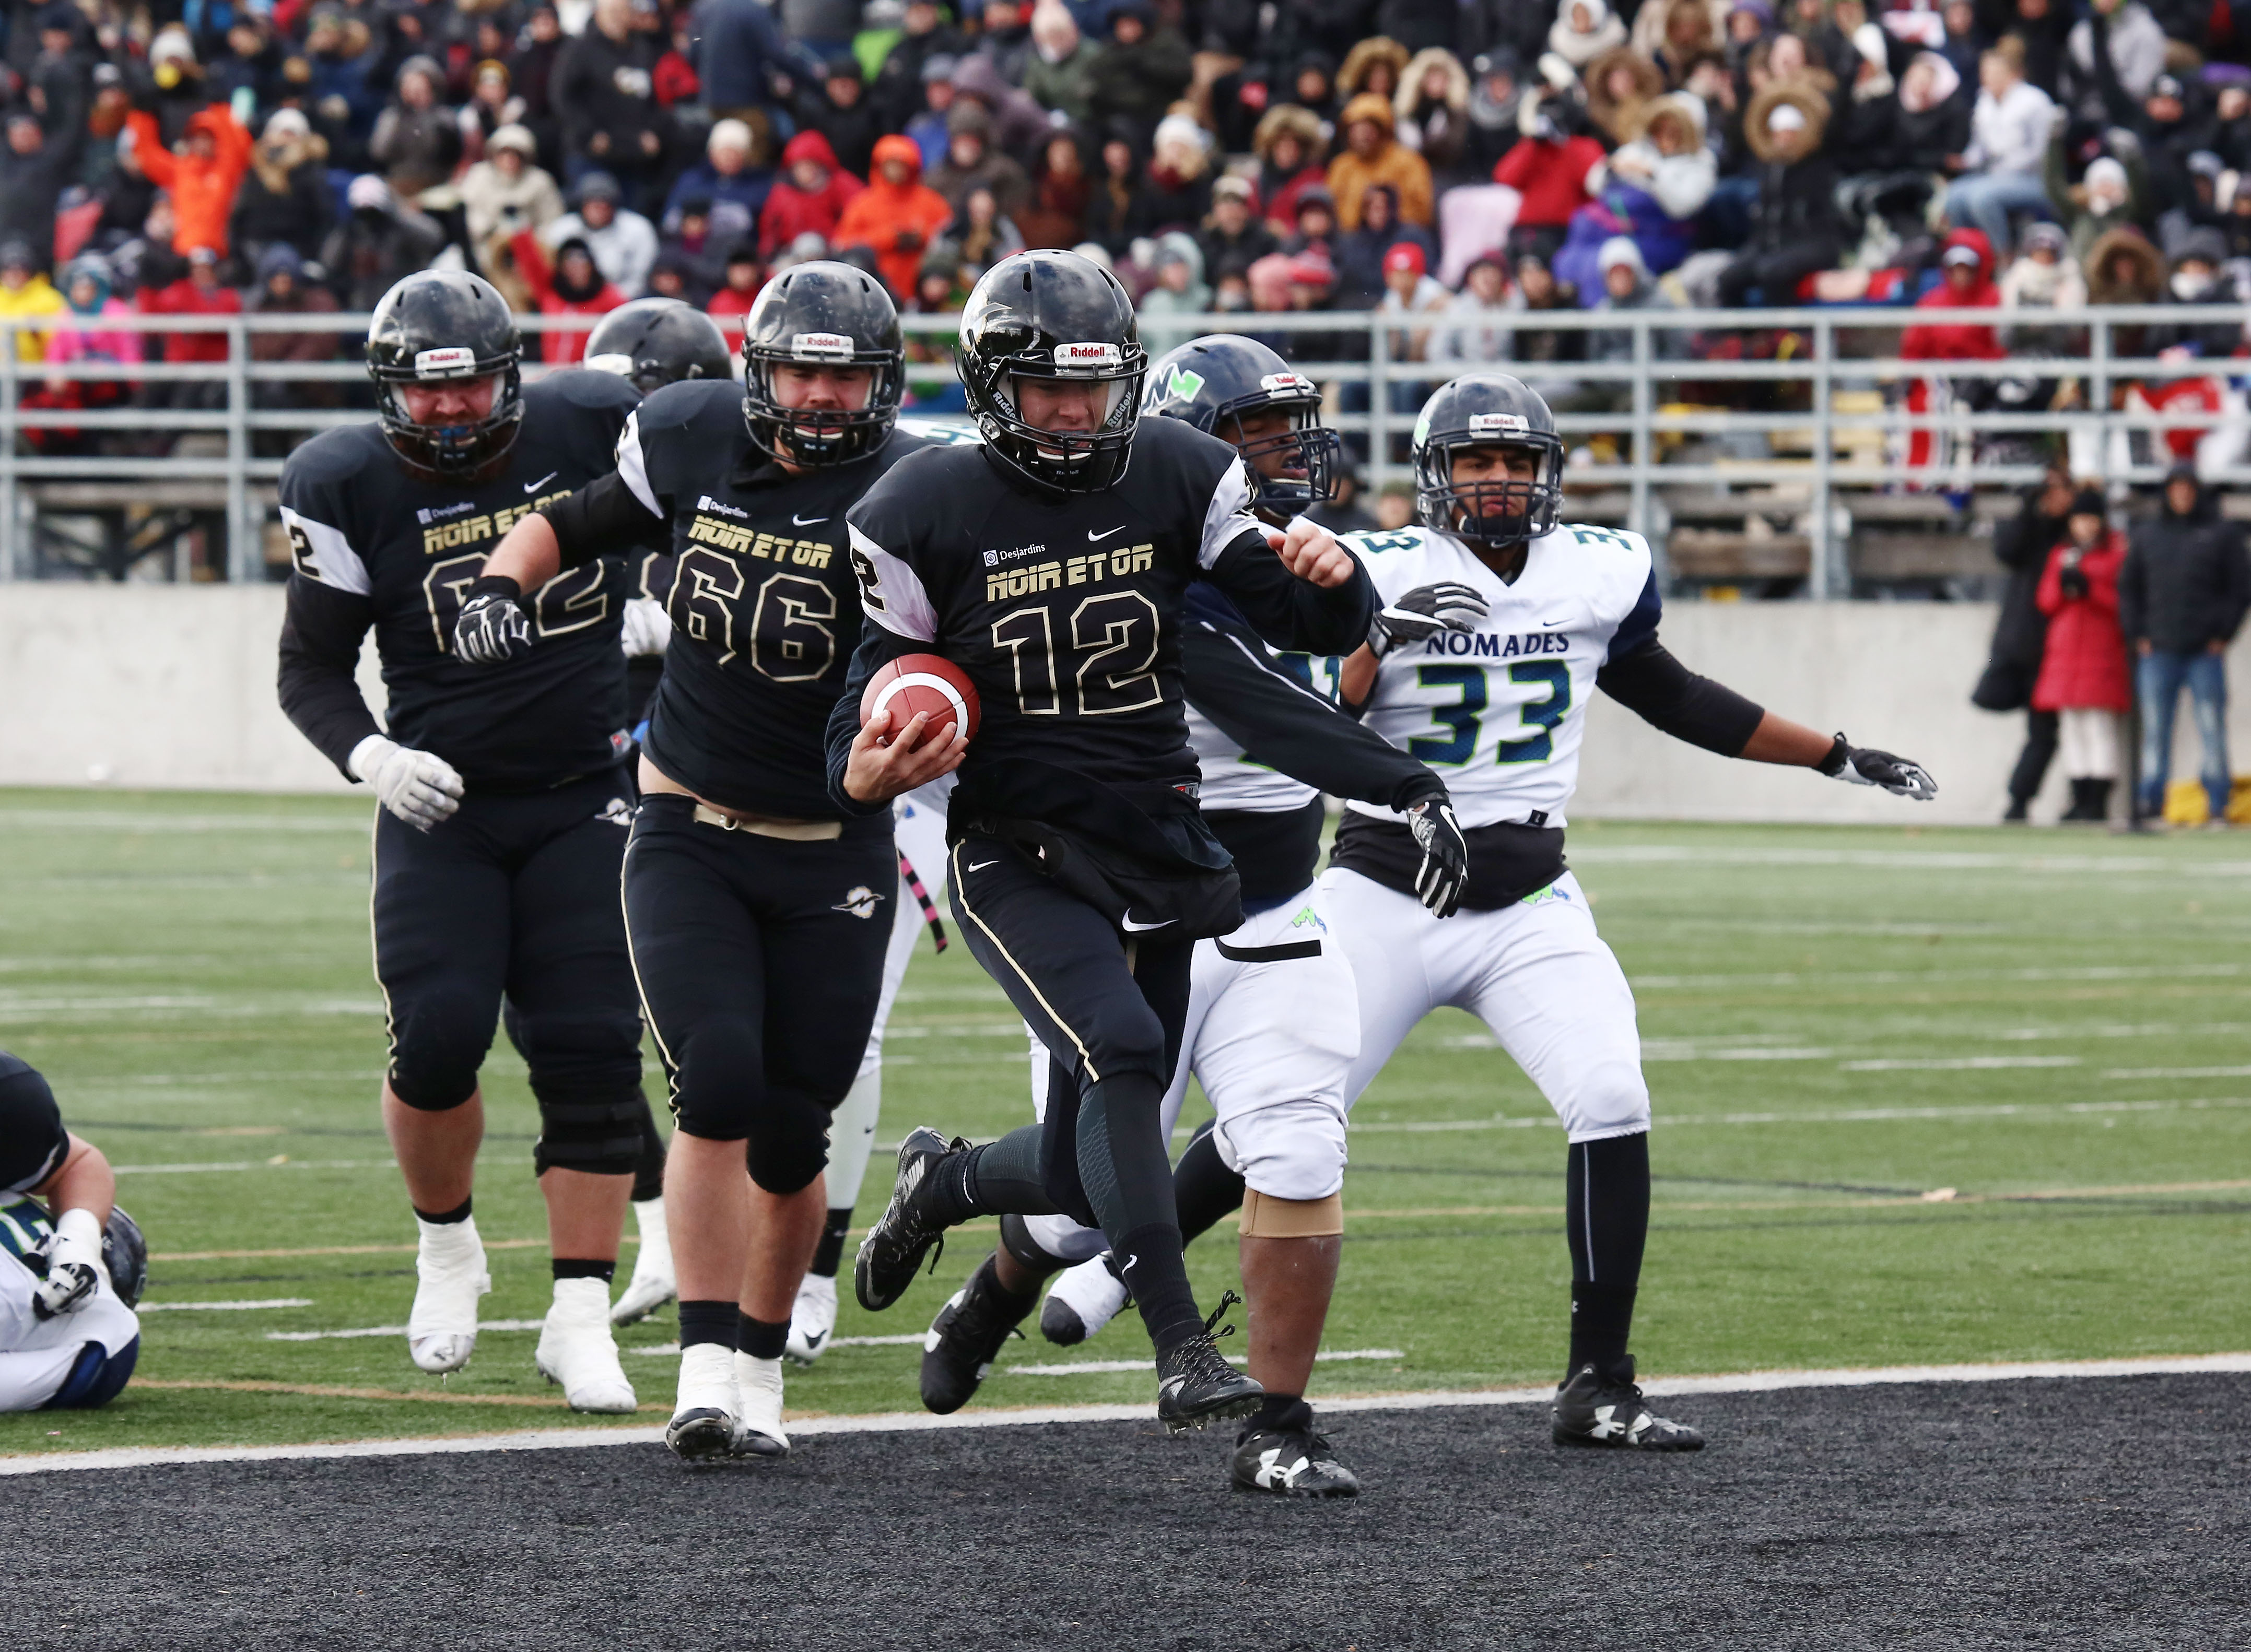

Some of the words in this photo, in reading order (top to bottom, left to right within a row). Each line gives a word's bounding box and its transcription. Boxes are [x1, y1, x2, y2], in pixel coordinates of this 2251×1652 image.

[806, 337, 840, 346] Riddell
[1071, 346, 1105, 357] Riddell
[424, 515, 492, 554] NOIR
[688, 515, 754, 553] NOIR
[751, 533, 794, 562] ET
[792, 540, 833, 569] OR
[1000, 544, 1046, 560] Desjardins
[987, 561, 1061, 602] NOIR
[1066, 553, 1107, 586] ET
[1111, 543, 1154, 576] OR
[666, 544, 837, 683] 66
[991, 589, 1163, 715] 12
[1426, 632, 1569, 657] NOMADES
[1408, 659, 1572, 767] 33
